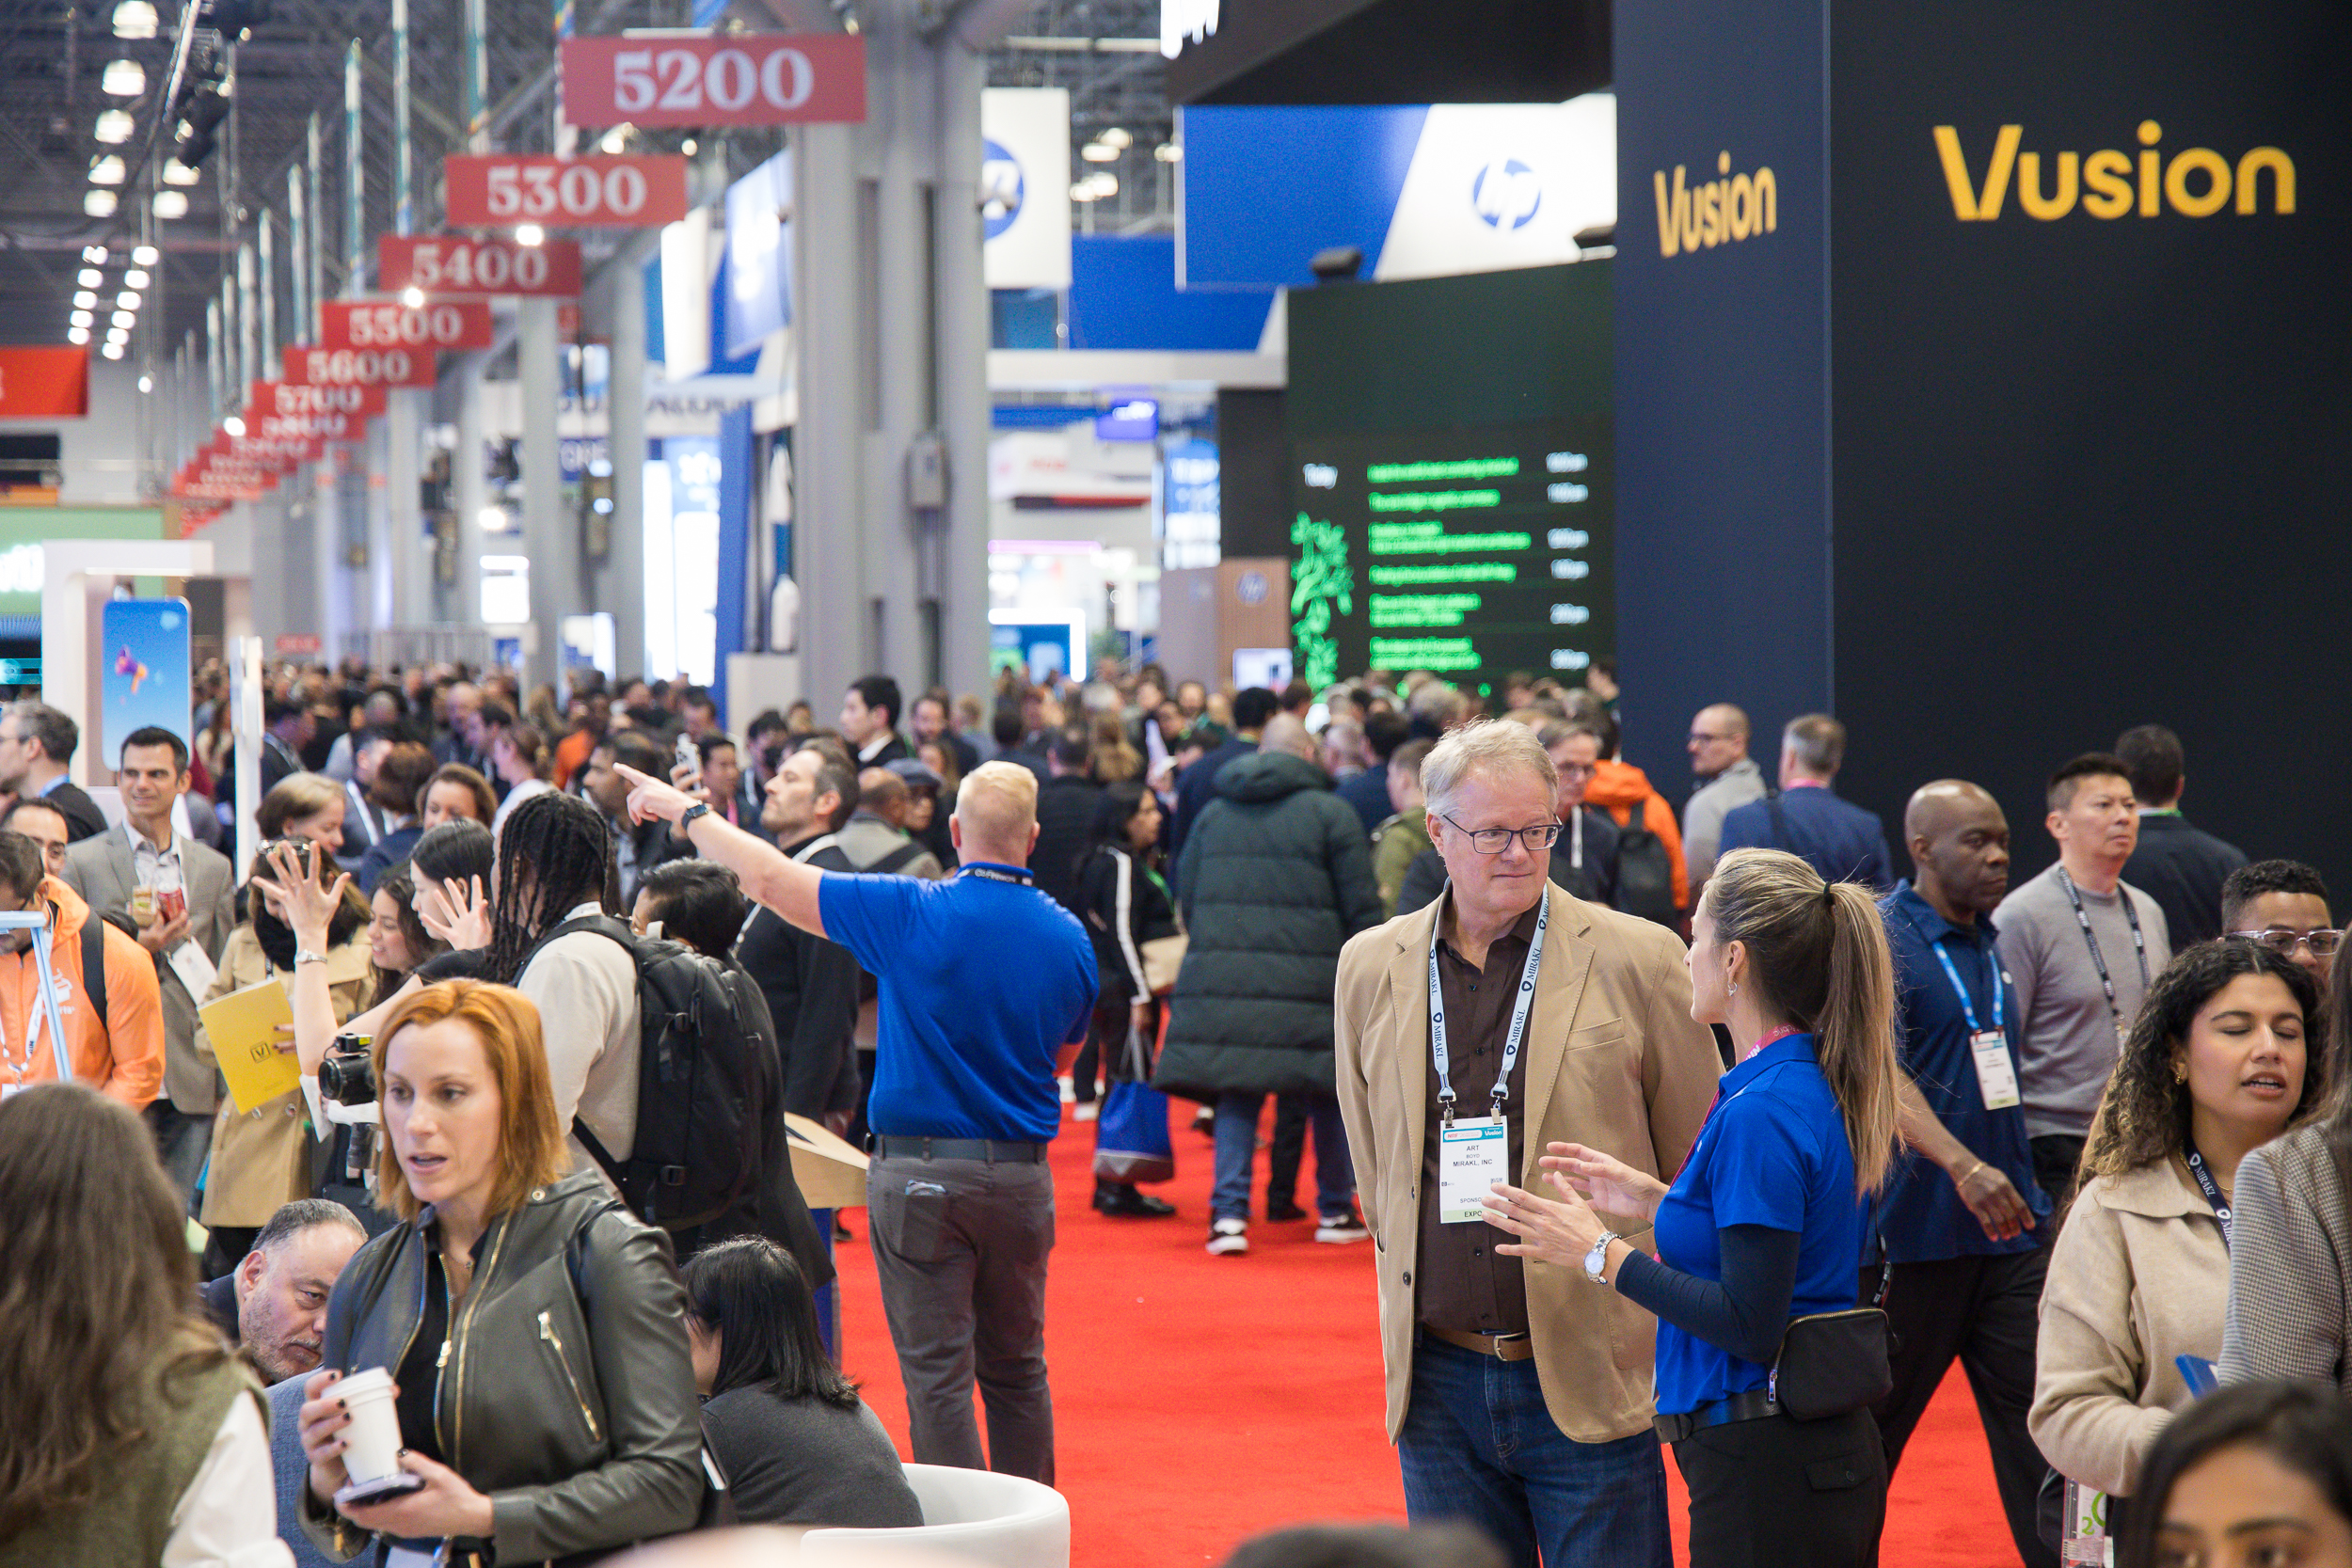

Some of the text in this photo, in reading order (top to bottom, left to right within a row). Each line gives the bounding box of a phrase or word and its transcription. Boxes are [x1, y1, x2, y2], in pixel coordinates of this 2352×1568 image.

[613, 48, 815, 112] 5200
[1932, 119, 2296, 222] Vusion
[486, 164, 647, 217] 5300
[1653, 150, 1777, 259] Vusion
[411, 243, 549, 289] 5400
[349, 306, 463, 345] 5500
[307, 348, 410, 386] 5600
[1429, 962, 1438, 996] MIRAKL
[1526, 947, 1542, 980] MIRAKL
[1434, 1025, 1444, 1059] MIRAKL
[1511, 1009, 1525, 1043] MIRAKL
[2195, 1165, 2217, 1197] MIRAKL
